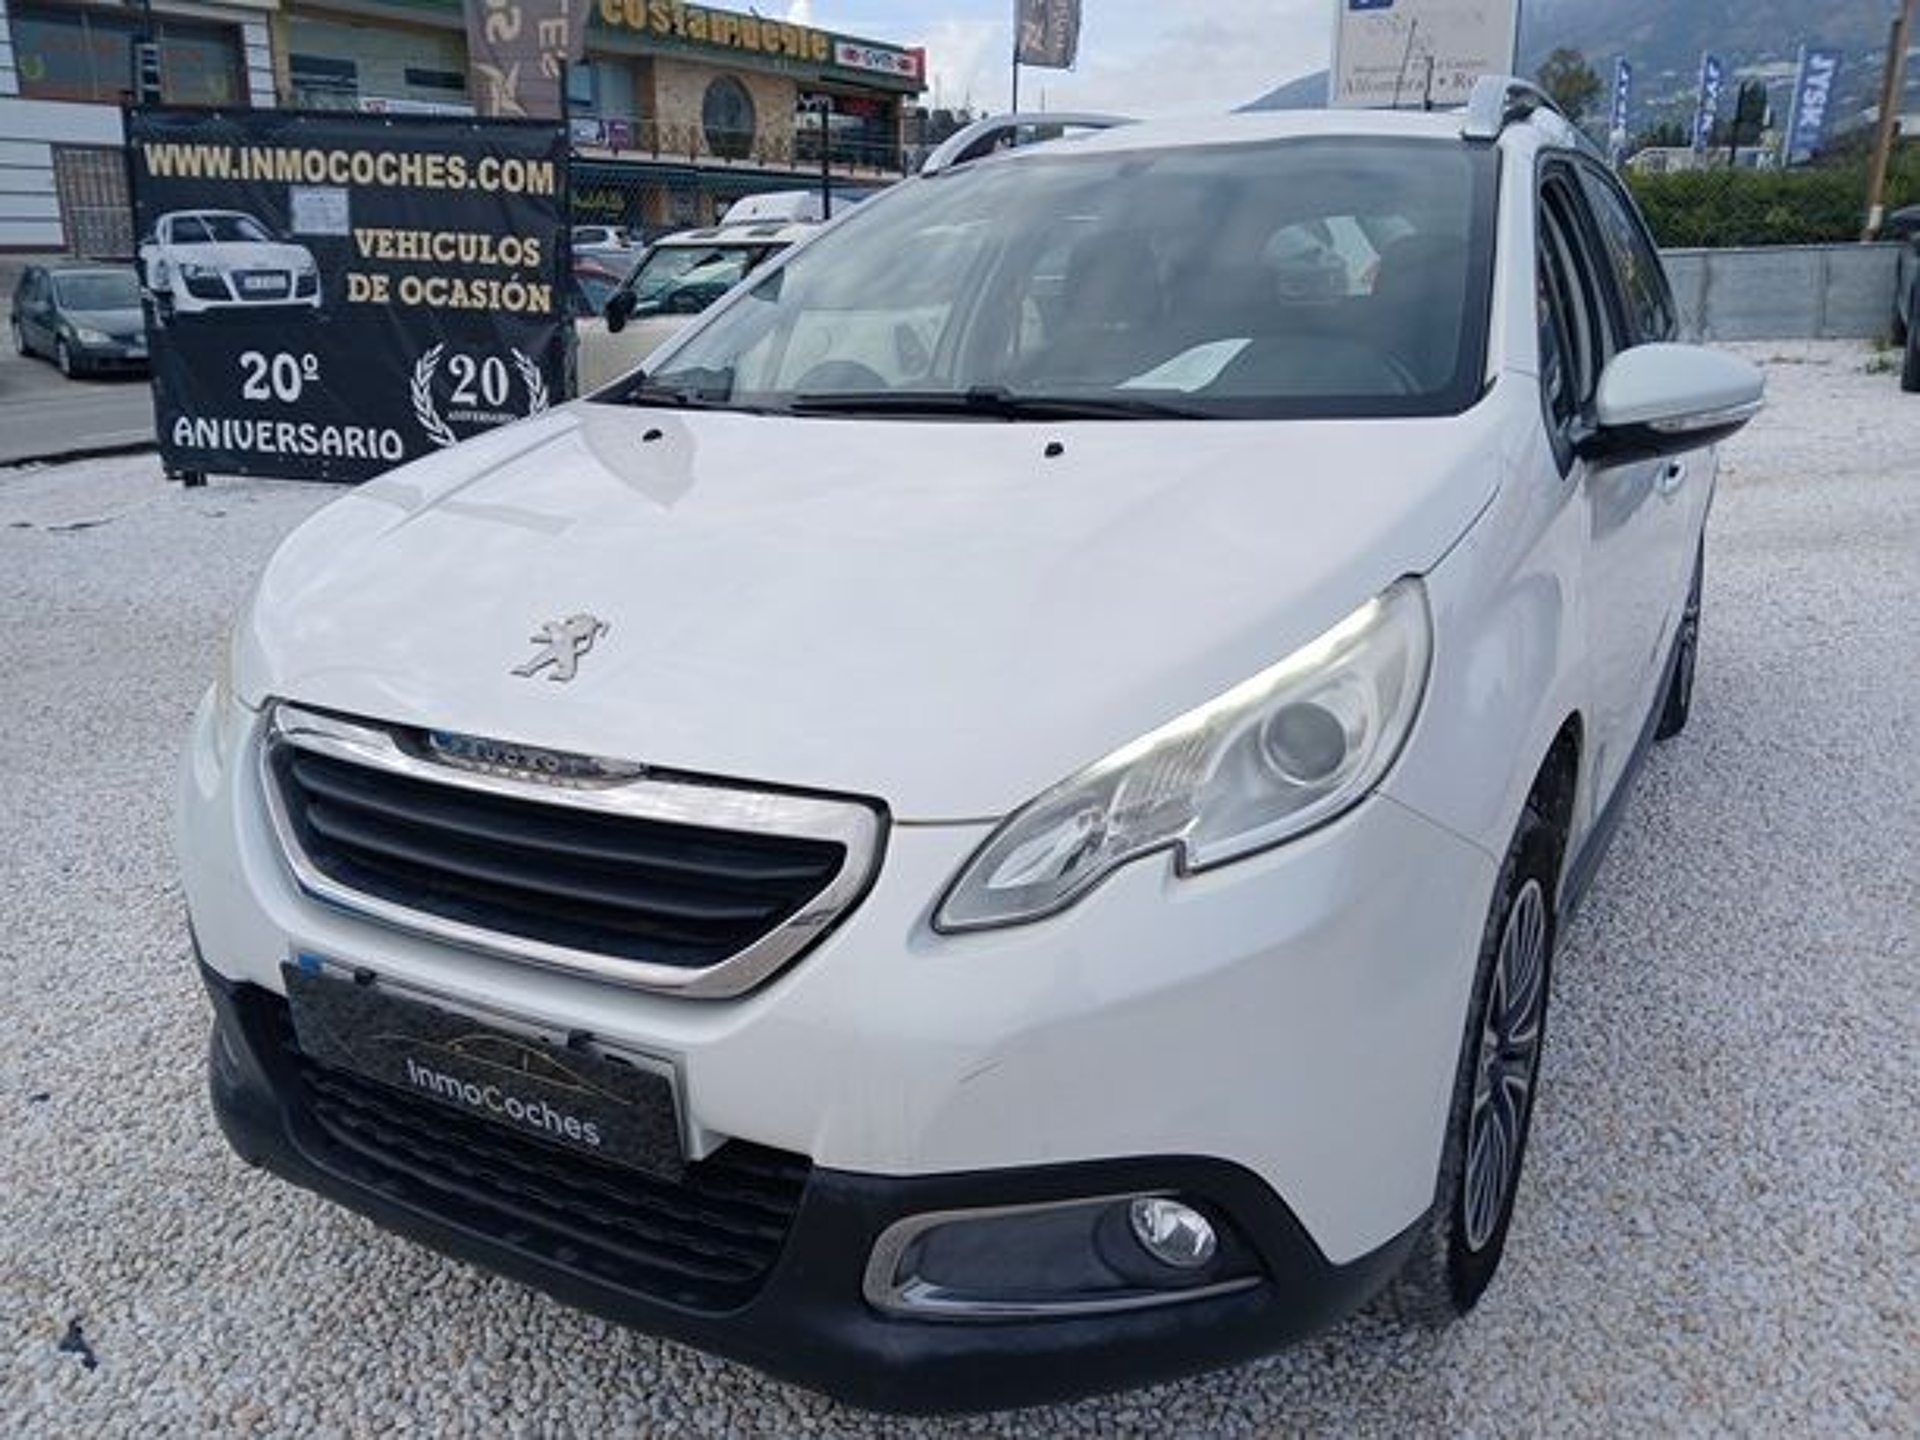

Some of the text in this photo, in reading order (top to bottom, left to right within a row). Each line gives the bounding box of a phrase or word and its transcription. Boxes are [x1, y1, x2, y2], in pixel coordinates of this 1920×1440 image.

[1799, 55, 1836, 127] JYSK
[143, 142, 555, 196] WWW.INMOCOCHES.COM
[354, 228, 541, 269] VEHICULOS
[348, 272, 552, 314] DE OCASIÓN
[239, 350, 321, 403] 20º
[448, 353, 510, 407] 20
[173, 416, 404, 460] ANIVERSARIO
[406, 1057, 602, 1147] InmoCoches
